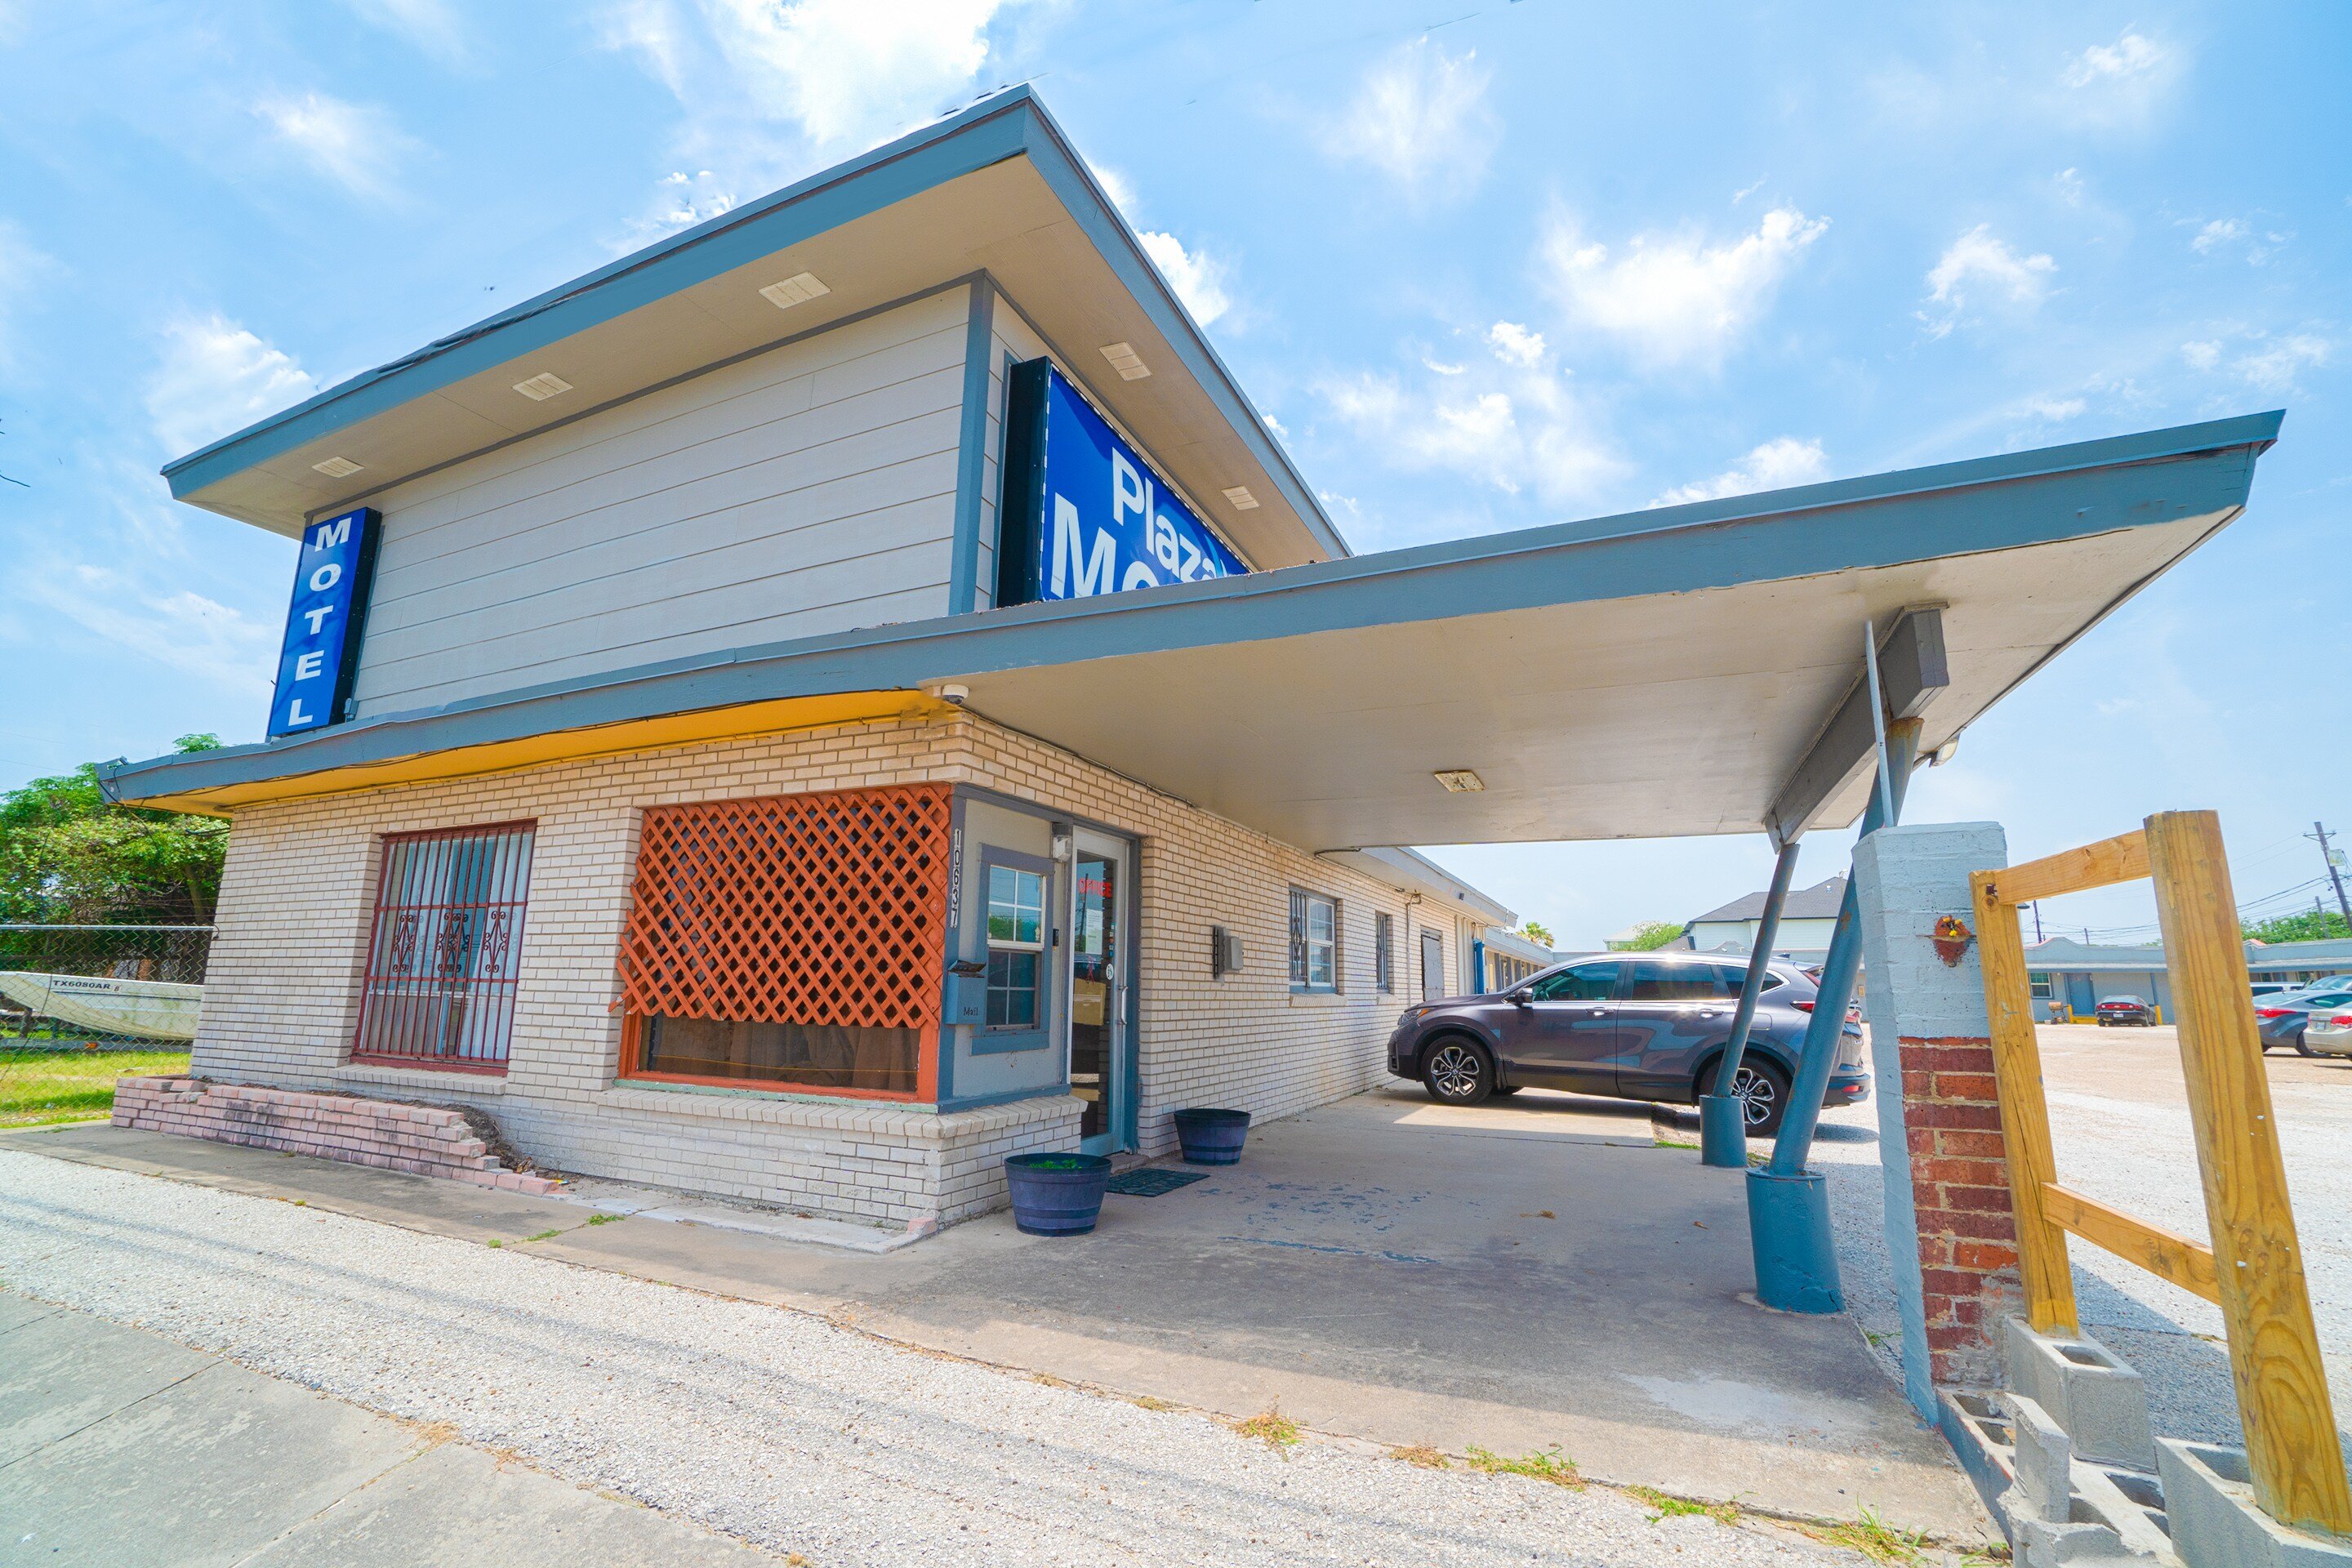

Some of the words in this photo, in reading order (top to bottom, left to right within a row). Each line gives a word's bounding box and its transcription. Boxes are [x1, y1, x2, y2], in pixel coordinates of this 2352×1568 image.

[287, 516, 352, 727] MOTEL
[951, 830, 961, 926] 10637
[1078, 877, 1112, 898] OFFICE
[963, 1006, 979, 1017] Mail
